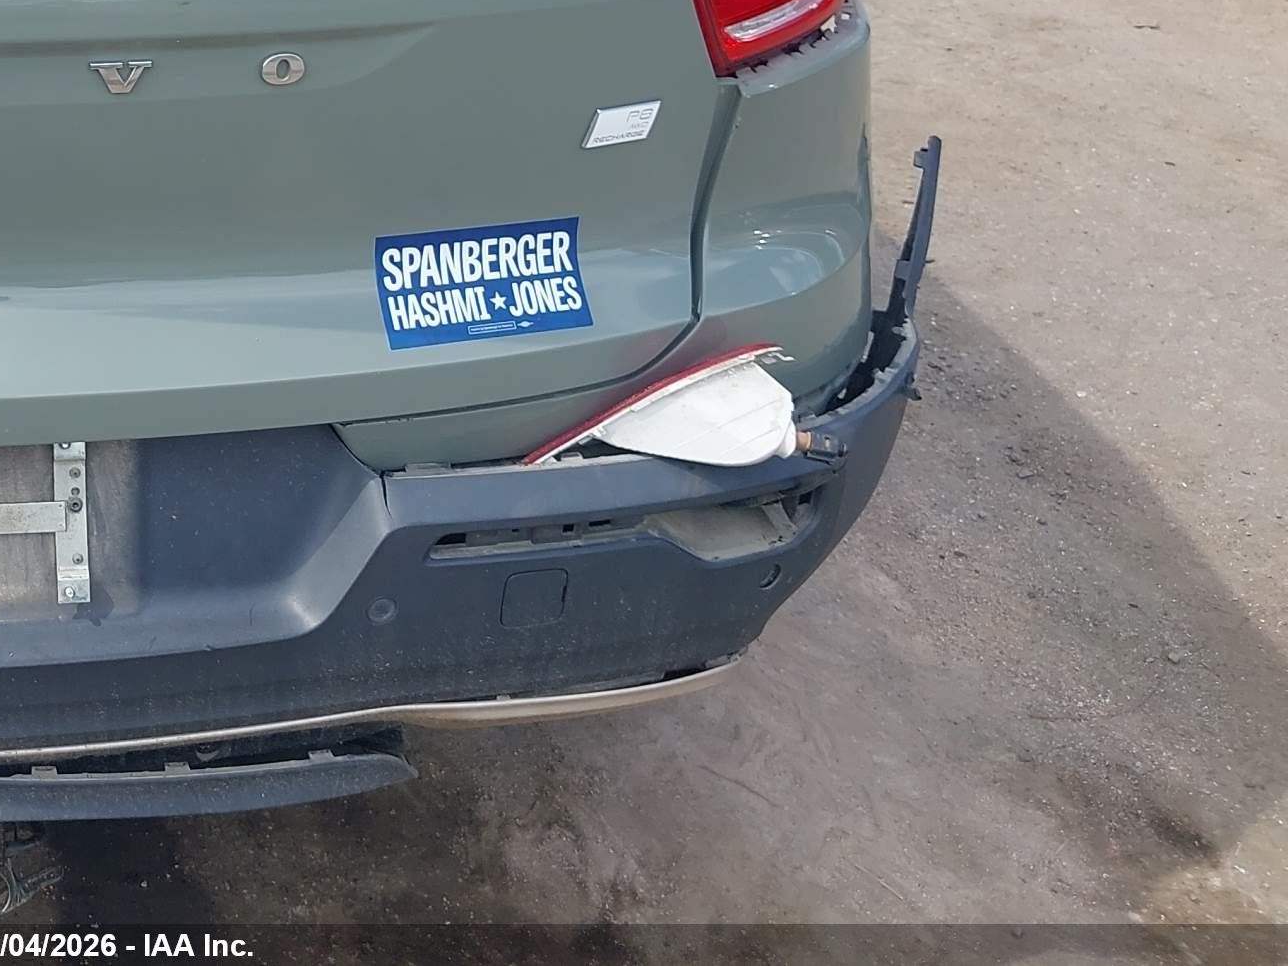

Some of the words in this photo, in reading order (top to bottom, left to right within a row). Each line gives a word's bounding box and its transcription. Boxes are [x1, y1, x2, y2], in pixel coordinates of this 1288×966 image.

[381, 231, 574, 292] SPANBERGER
[387, 286, 492, 331] HASHMI
[509, 276, 583, 317] JONES
